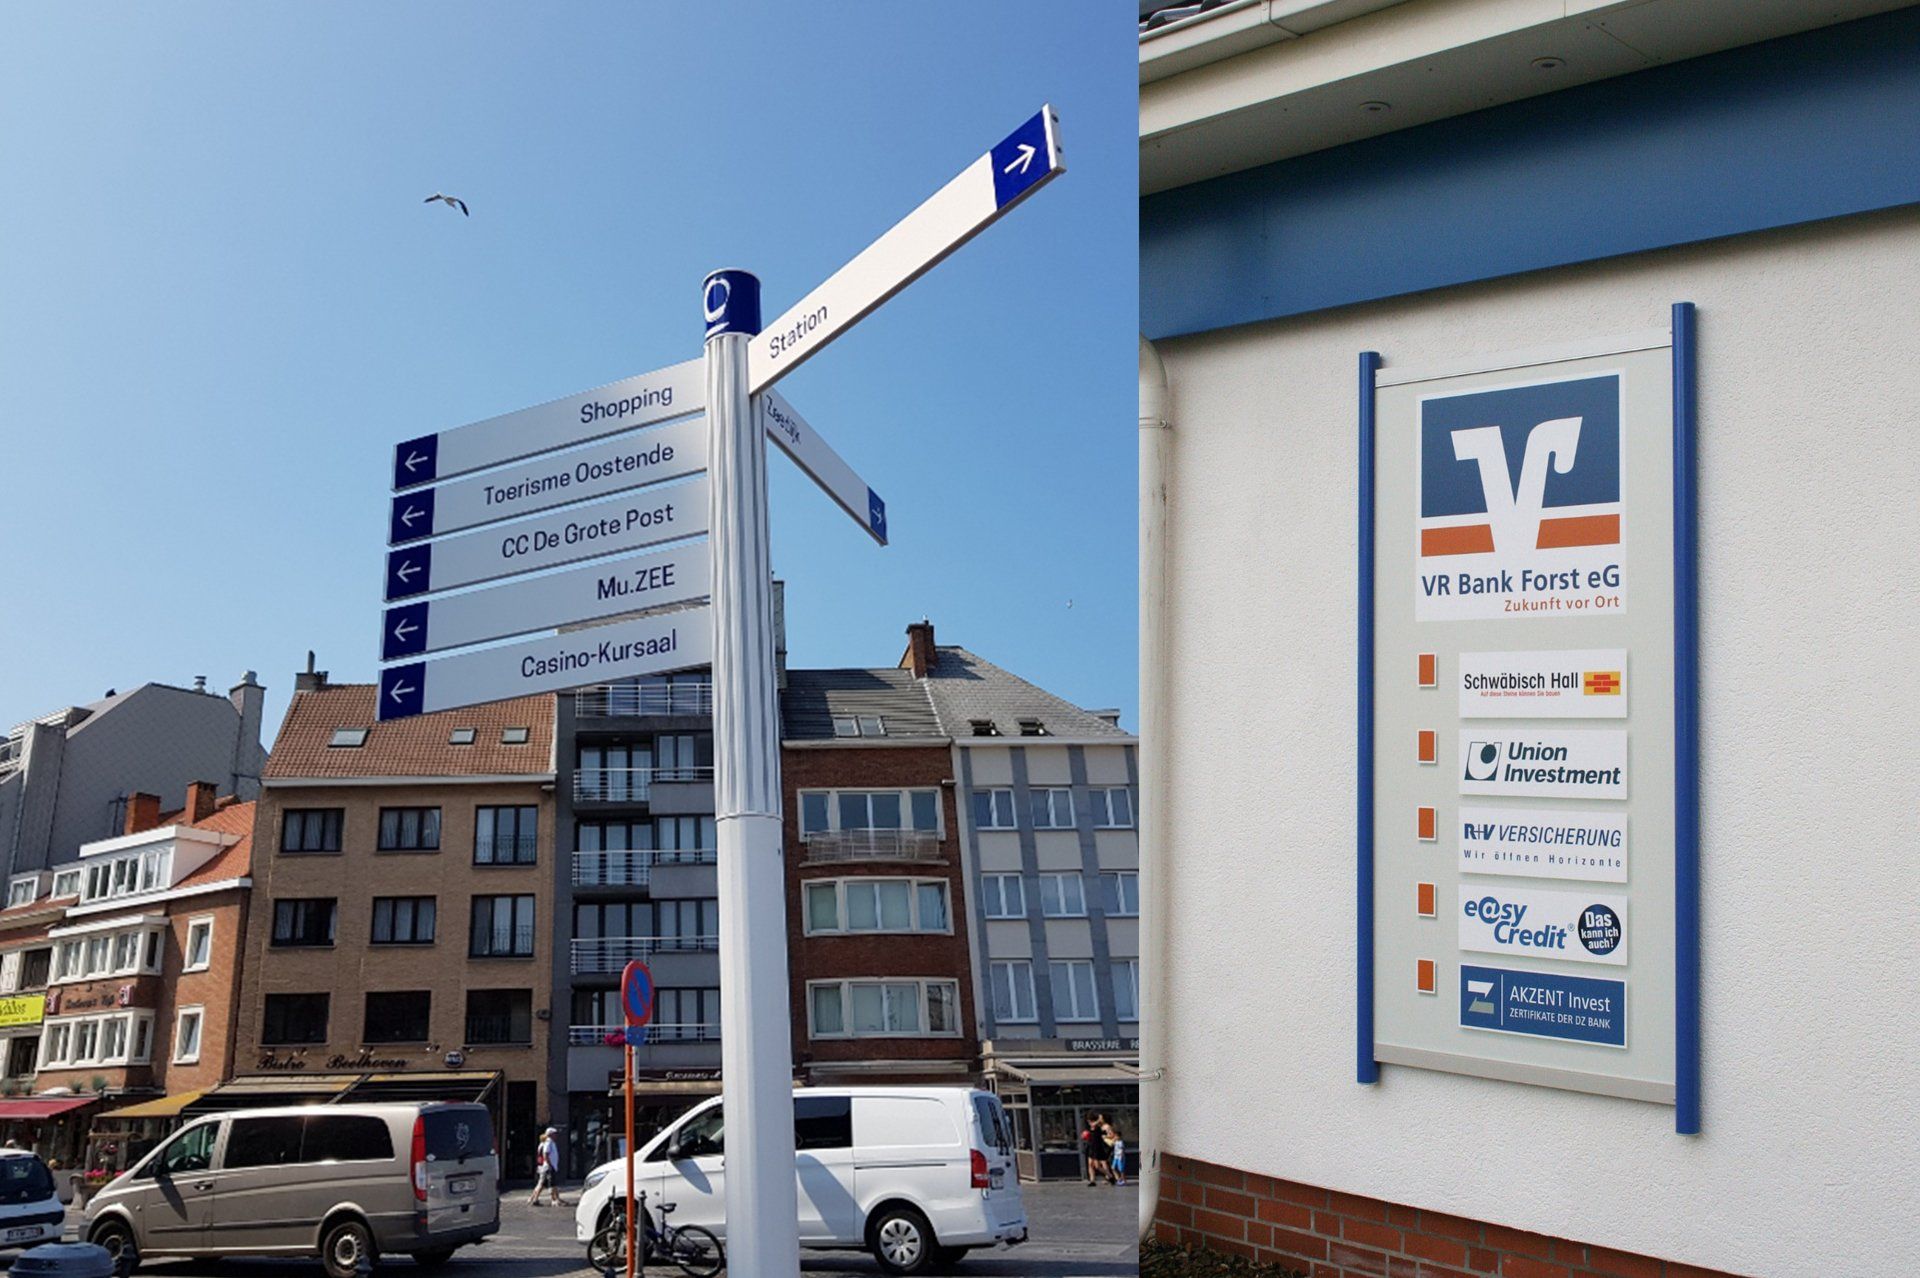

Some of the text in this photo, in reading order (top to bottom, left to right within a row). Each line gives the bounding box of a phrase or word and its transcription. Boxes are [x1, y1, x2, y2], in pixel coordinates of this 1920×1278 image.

[768, 304, 829, 359] Station
[580, 386, 673, 424] Shopping
[484, 443, 675, 505] Toerisme Oostende
[501, 503, 674, 559] CC De Grote Post
[597, 563, 676, 600] Mu.ZEE
[1422, 564, 1620, 596] VR Bank Forst eG
[1504, 595, 1620, 612] Zukunft vor Ort
[521, 628, 677, 678] Casino-Kursaal
[1464, 672, 1578, 690] Schwäbisch Hall
[1508, 742, 1568, 761] Union
[1504, 764, 1621, 785] Investment
[1463, 823, 1622, 847] R+V VERSICHERUNG
[1463, 849, 1621, 868] Wir öffnen Horizonte
[1584, 911, 1613, 928] Das
[1580, 927, 1619, 939] kann ich
[1588, 937, 1614, 949] auch!
[1509, 985, 1611, 1012] AKZENT Invest
[1509, 1007, 1611, 1029] ZERTIFIKATE DER DZ BANK
